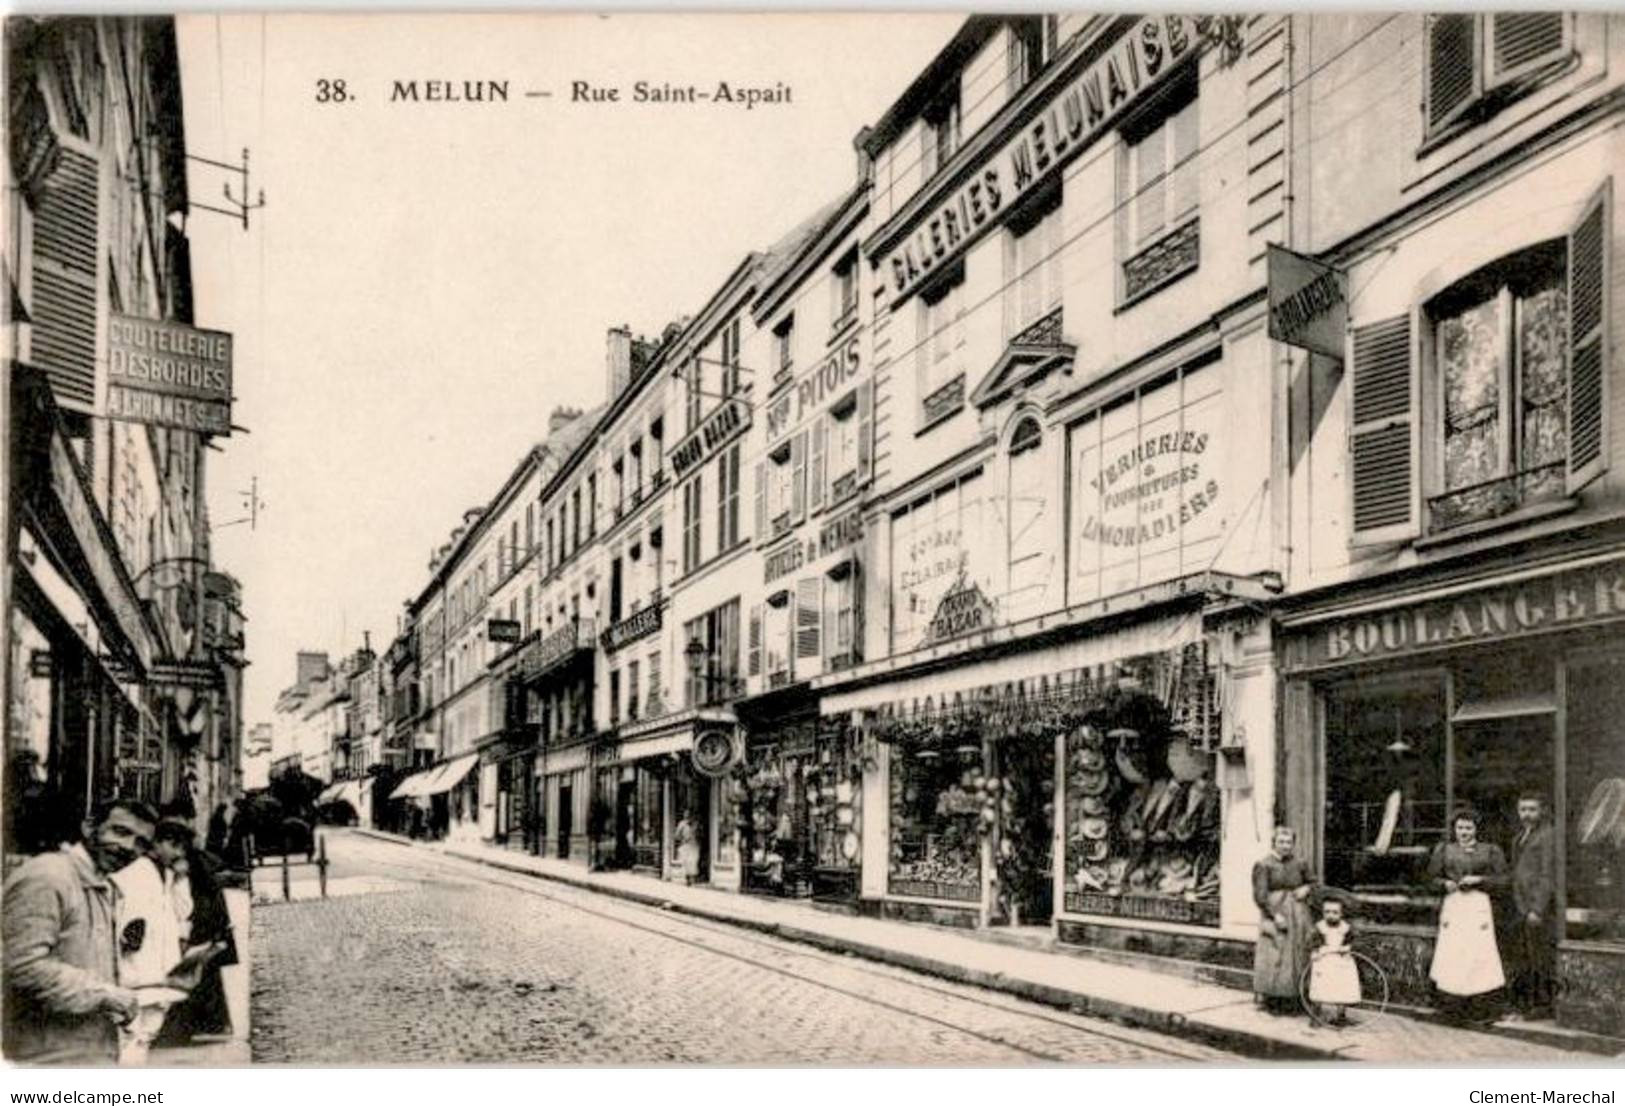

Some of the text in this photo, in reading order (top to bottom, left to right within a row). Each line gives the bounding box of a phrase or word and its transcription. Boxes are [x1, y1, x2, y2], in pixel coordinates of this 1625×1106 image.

[892, 169, 1001, 291] GALERIES
[108, 347, 226, 391] DESBORDES
[110, 319, 227, 361] COUTELLERIE
[797, 338, 860, 421] PITOIS
[1090, 430, 1209, 497] VERRERIES
[1082, 479, 1219, 548] LIMONADIERS
[935, 607, 983, 639] BAZAR
